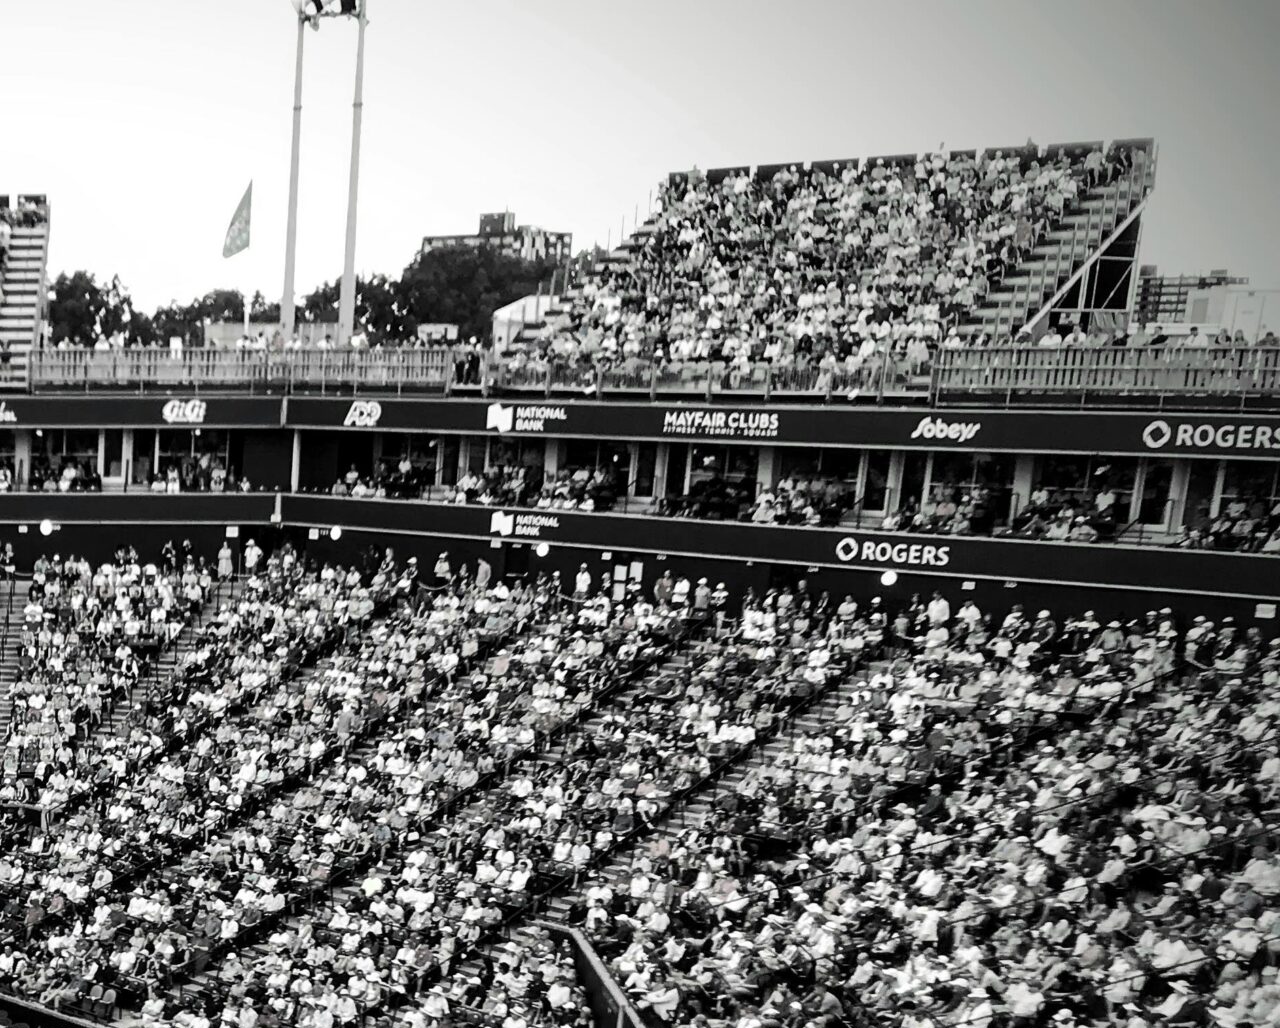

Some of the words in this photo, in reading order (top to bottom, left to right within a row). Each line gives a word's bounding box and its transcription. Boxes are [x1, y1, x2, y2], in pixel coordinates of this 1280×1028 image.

[344, 401, 382, 427] ADP
[516, 406, 567, 420] NATIONAL
[664, 410, 726, 427] MAYFAIR
[727, 412, 779, 429] CLUBS
[515, 418, 544, 431] BANK
[910, 416, 981, 442] Sobeys
[1175, 424, 1280, 449] ROGERS
[516, 514, 560, 527] NATIONAL
[515, 525, 540, 536] BANK
[861, 541, 950, 566] ROGERS
